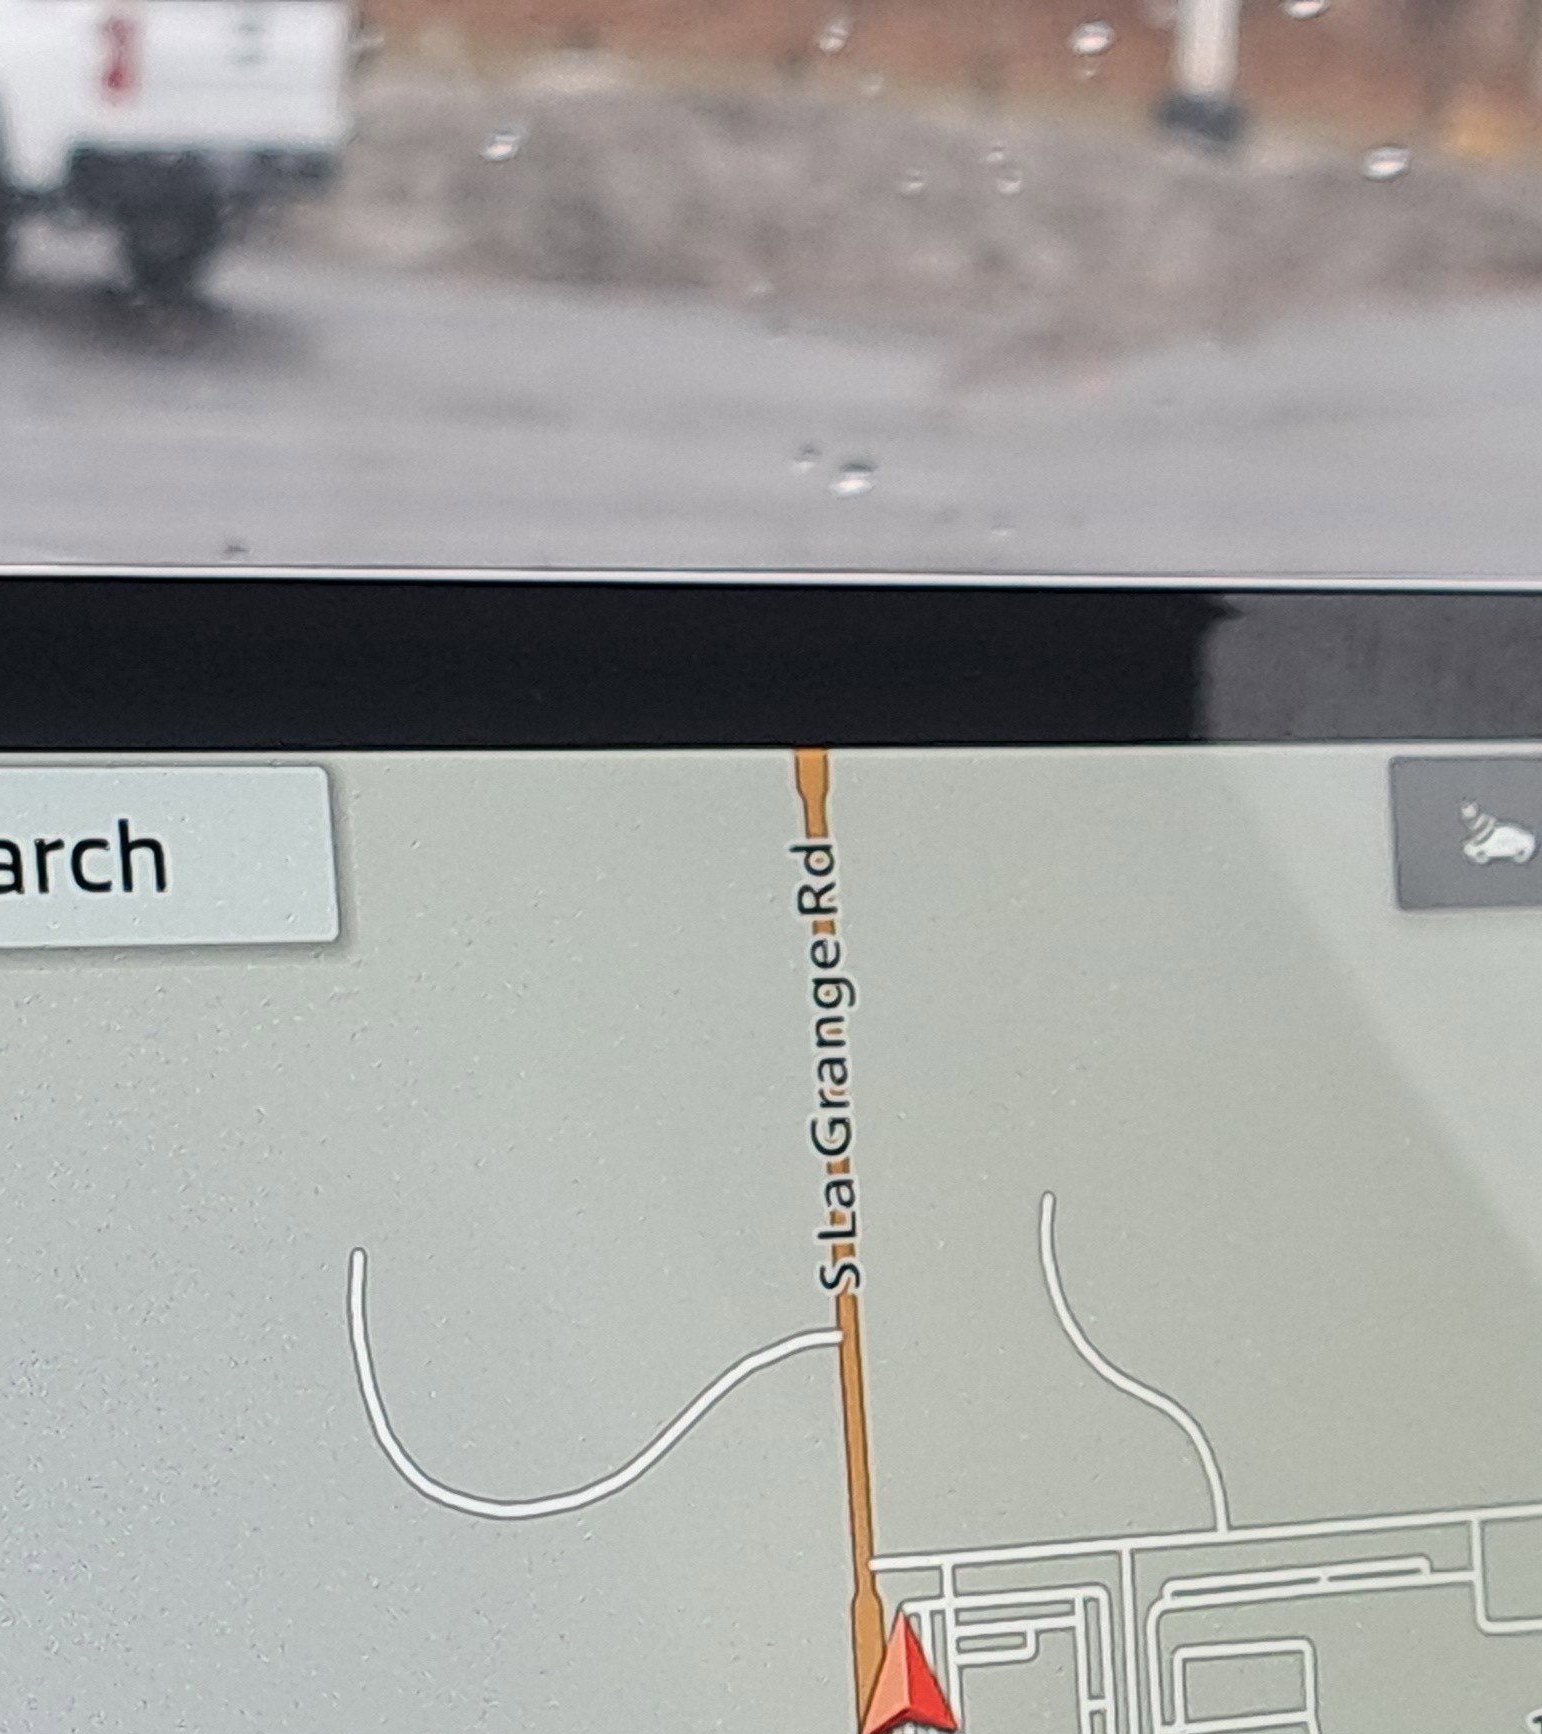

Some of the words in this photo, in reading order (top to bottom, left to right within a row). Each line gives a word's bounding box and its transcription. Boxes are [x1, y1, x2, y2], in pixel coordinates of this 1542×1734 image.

[789, 842, 839, 917] Rd
[810, 937, 856, 1157] Grange
[816, 1177, 856, 1240] La
[818, 1260, 861, 1292] S
